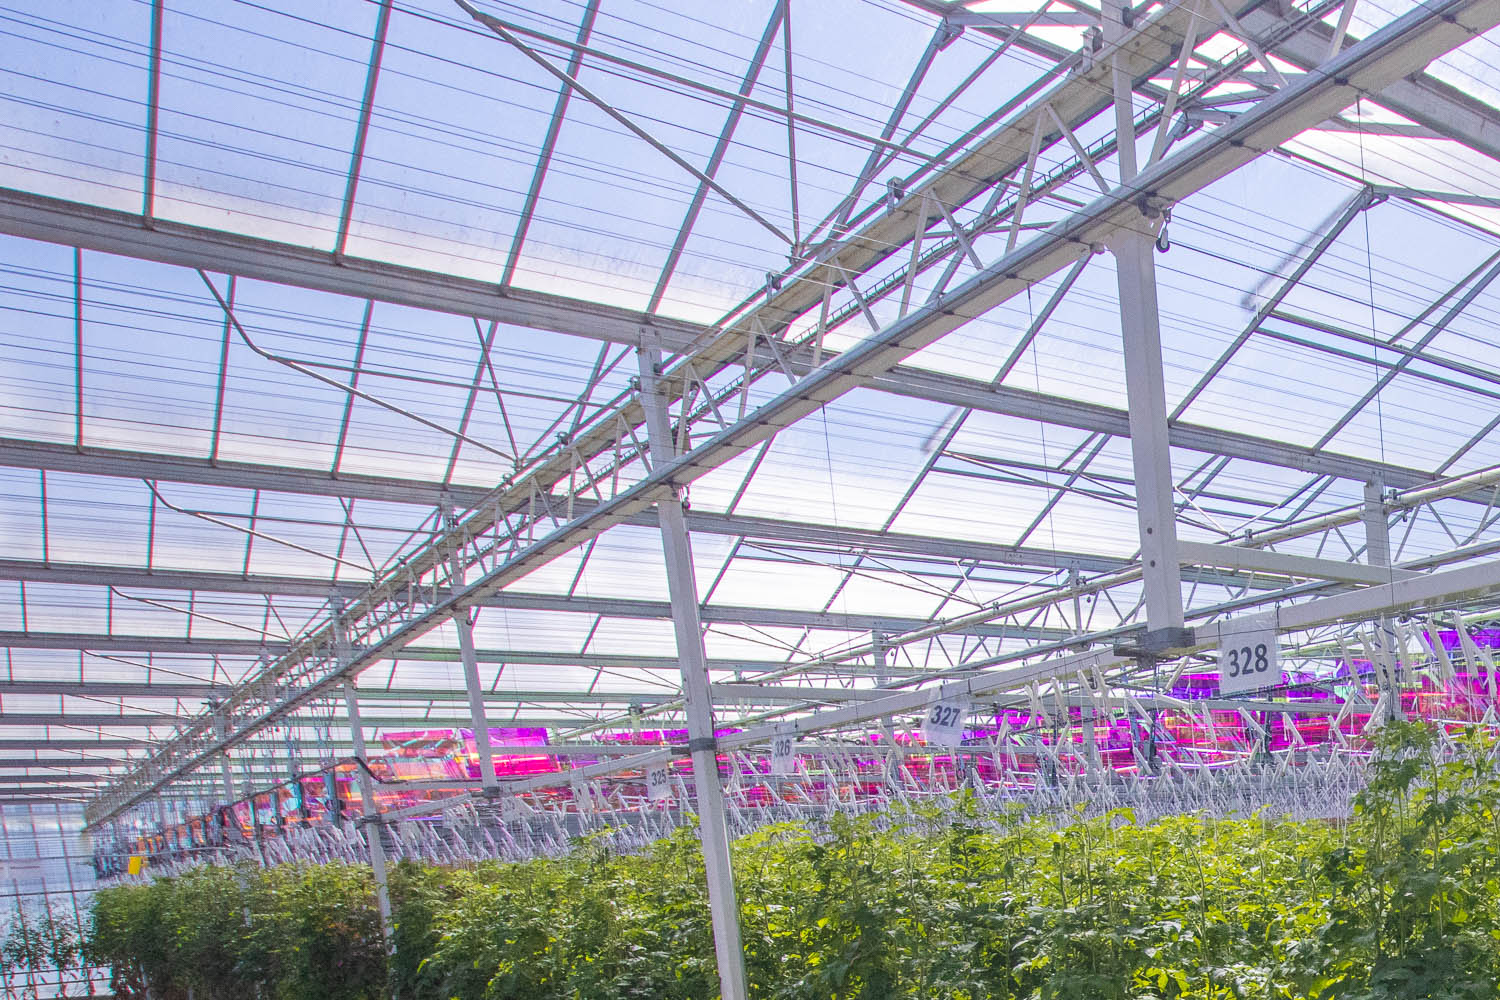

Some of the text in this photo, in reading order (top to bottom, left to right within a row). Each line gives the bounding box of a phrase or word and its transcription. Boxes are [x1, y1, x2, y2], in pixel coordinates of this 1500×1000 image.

[1228, 643, 1269, 678] 328
[930, 705, 961, 728] 327
[651, 768, 667, 786] 325
